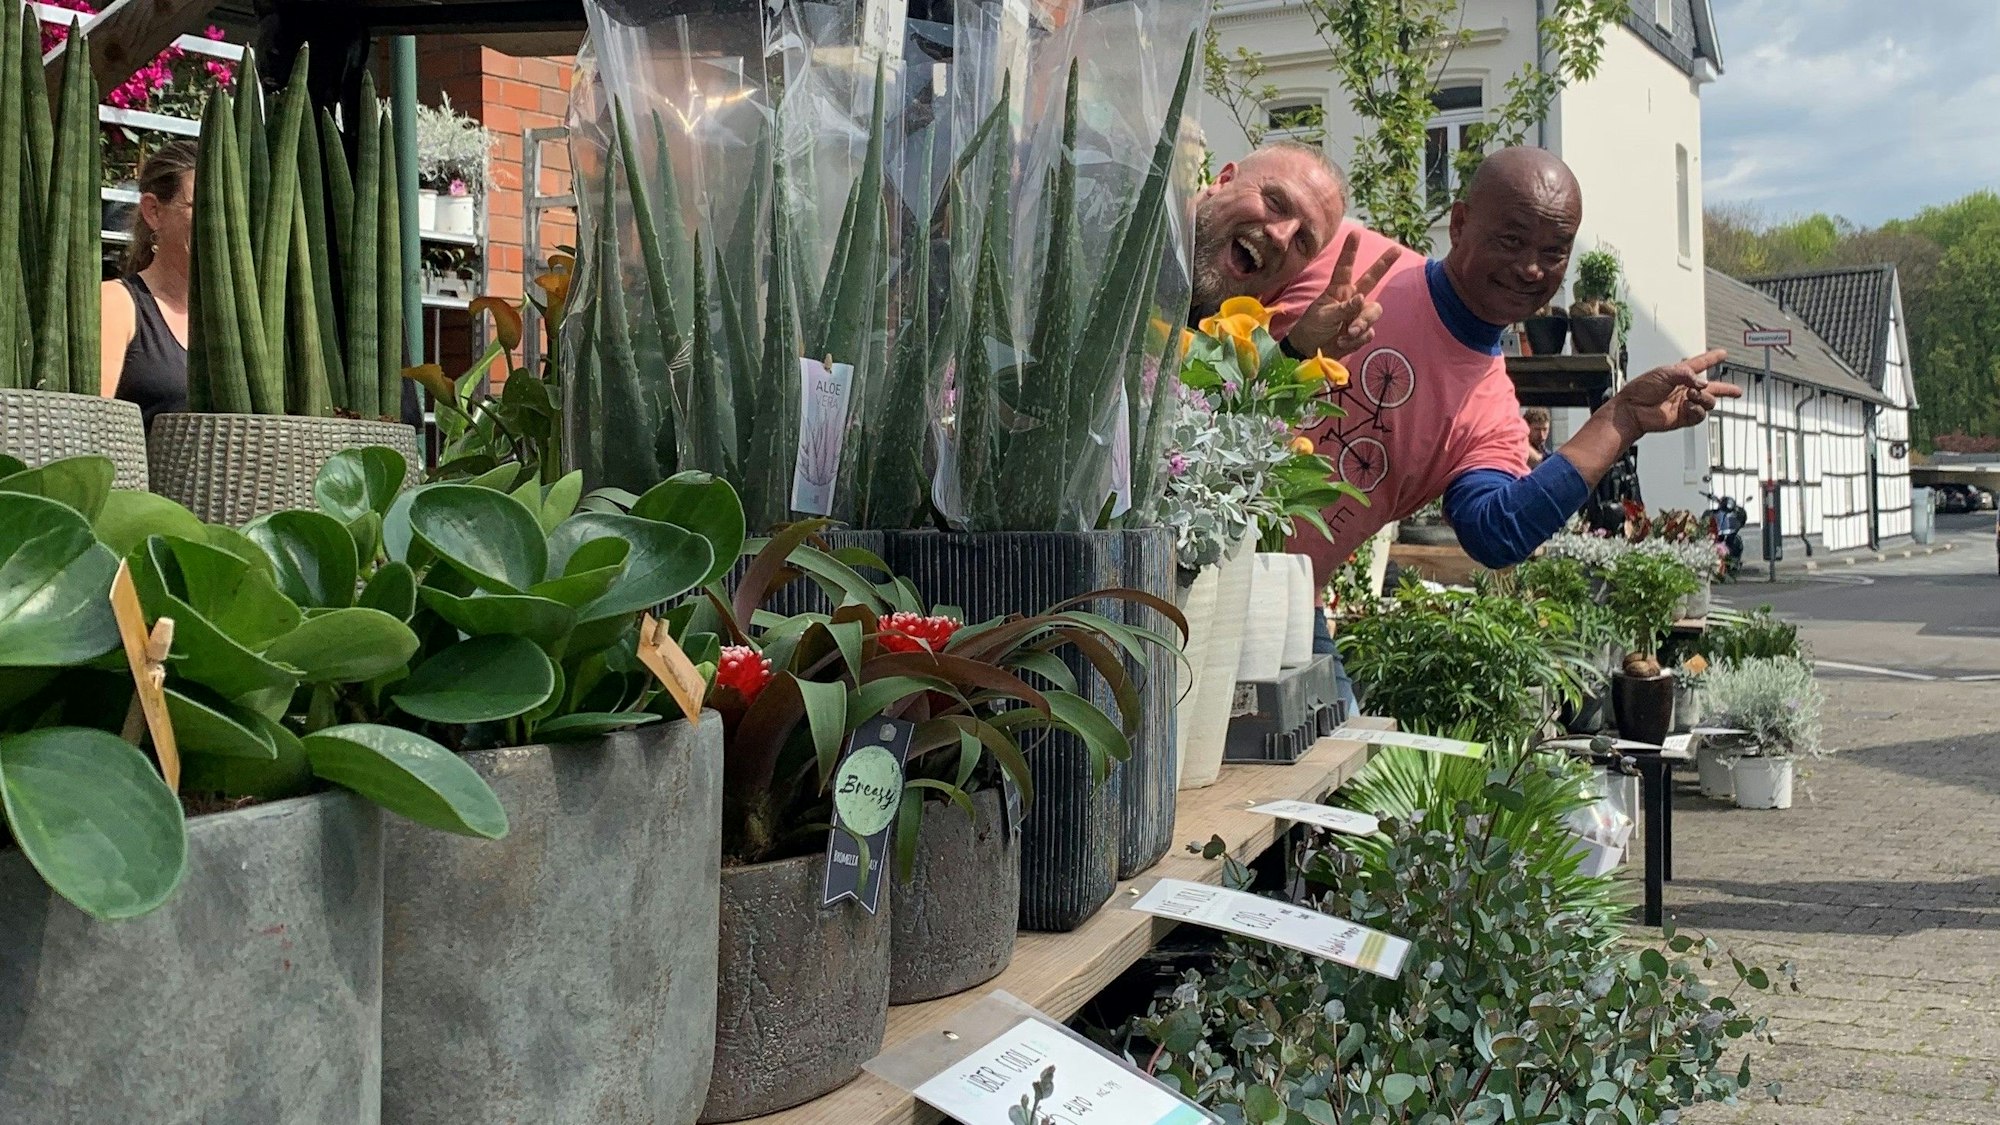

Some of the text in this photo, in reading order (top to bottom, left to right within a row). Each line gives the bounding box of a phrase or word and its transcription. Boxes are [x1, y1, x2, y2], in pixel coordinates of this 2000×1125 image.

[816, 380, 842, 396] ALOE
[815, 394, 839, 409] VERA
[960, 1065, 1012, 1093] ÜBER
[1062, 1095, 1093, 1117] euro
